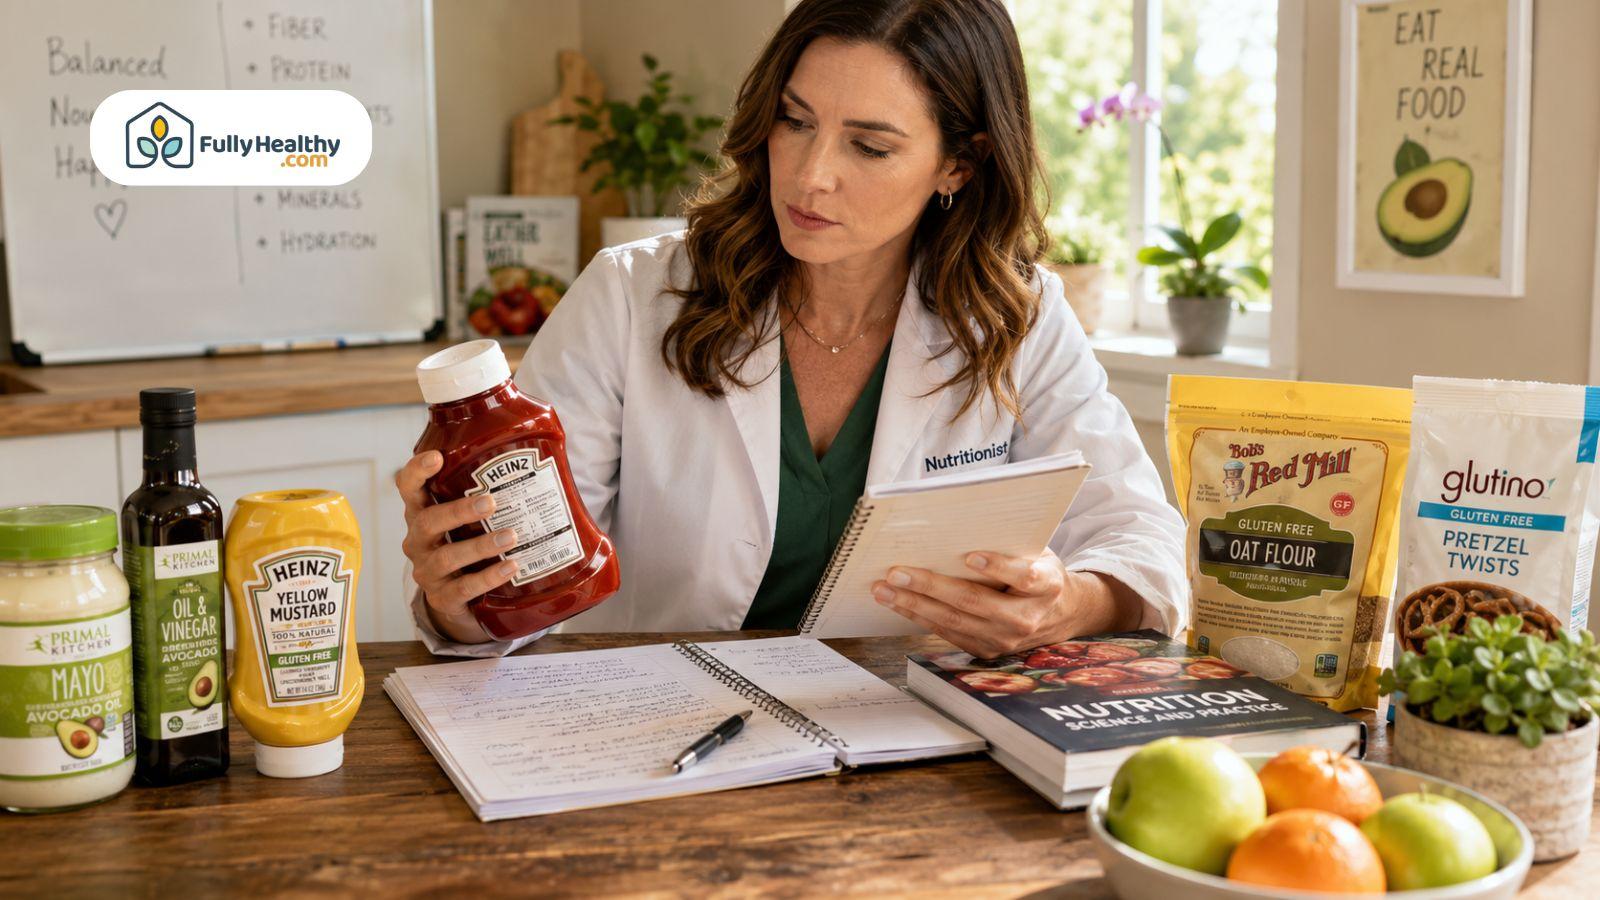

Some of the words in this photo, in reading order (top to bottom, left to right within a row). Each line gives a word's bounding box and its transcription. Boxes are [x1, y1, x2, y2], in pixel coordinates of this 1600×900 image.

[269, 13, 327, 40] FIBER
[1395, 10, 1441, 45] EAT
[47, 36, 168, 78] Balanced
[271, 55, 352, 82] PROTEIN
[1421, 46, 1484, 81] REAL
[50, 96, 95, 127] Nou
[1396, 86, 1466, 120] FOOD
[278, 189, 363, 210] MINERALS
[280, 230, 378, 254] HYDRATION
[925, 441, 1008, 472] Nutritionist
[1228, 443, 1265, 459] Bob's
[487, 458, 529, 483] HEINZ
[1245, 454, 1300, 498] Red
[1298, 447, 1352, 488] Mill
[1441, 459, 1545, 504] glutino
[1334, 500, 1352, 509] GF
[1238, 518, 1282, 533] GLUTEN
[1285, 522, 1314, 536] FREE
[1450, 508, 1500, 523] GLUTEN
[1502, 514, 1534, 527] FREE
[1229, 539, 1261, 562] OAT
[1265, 542, 1316, 568] FLOUR
[1443, 529, 1529, 556] PRETZEL
[172, 549, 213, 562] PRIMAL
[173, 559, 215, 570] KITCHEN
[1447, 552, 1520, 577] TWISTS
[273, 560, 330, 582] HEINZ
[172, 597, 194, 619] OIL
[198, 595, 207, 616] &
[277, 587, 328, 606] YELLOW
[270, 601, 336, 622] MUSTARD
[51, 624, 111, 646] PRIMAL
[161, 615, 217, 642] VINEGAR
[299, 628, 335, 638] NATURAL
[51, 639, 112, 655] KITCHEN
[162, 646, 218, 663] AVOCADO
[278, 653, 311, 665] GLUTEN
[313, 650, 332, 661] FREE
[51, 662, 105, 702] MAYO
[26, 703, 102, 724] AVOCADO
[105, 698, 122, 711] OIL
[1040, 688, 1270, 721] NUTRITION
[1065, 715, 1153, 731] SCIENCE
[1154, 710, 1195, 722] AND
[1196, 702, 1289, 718] PRACTICE
